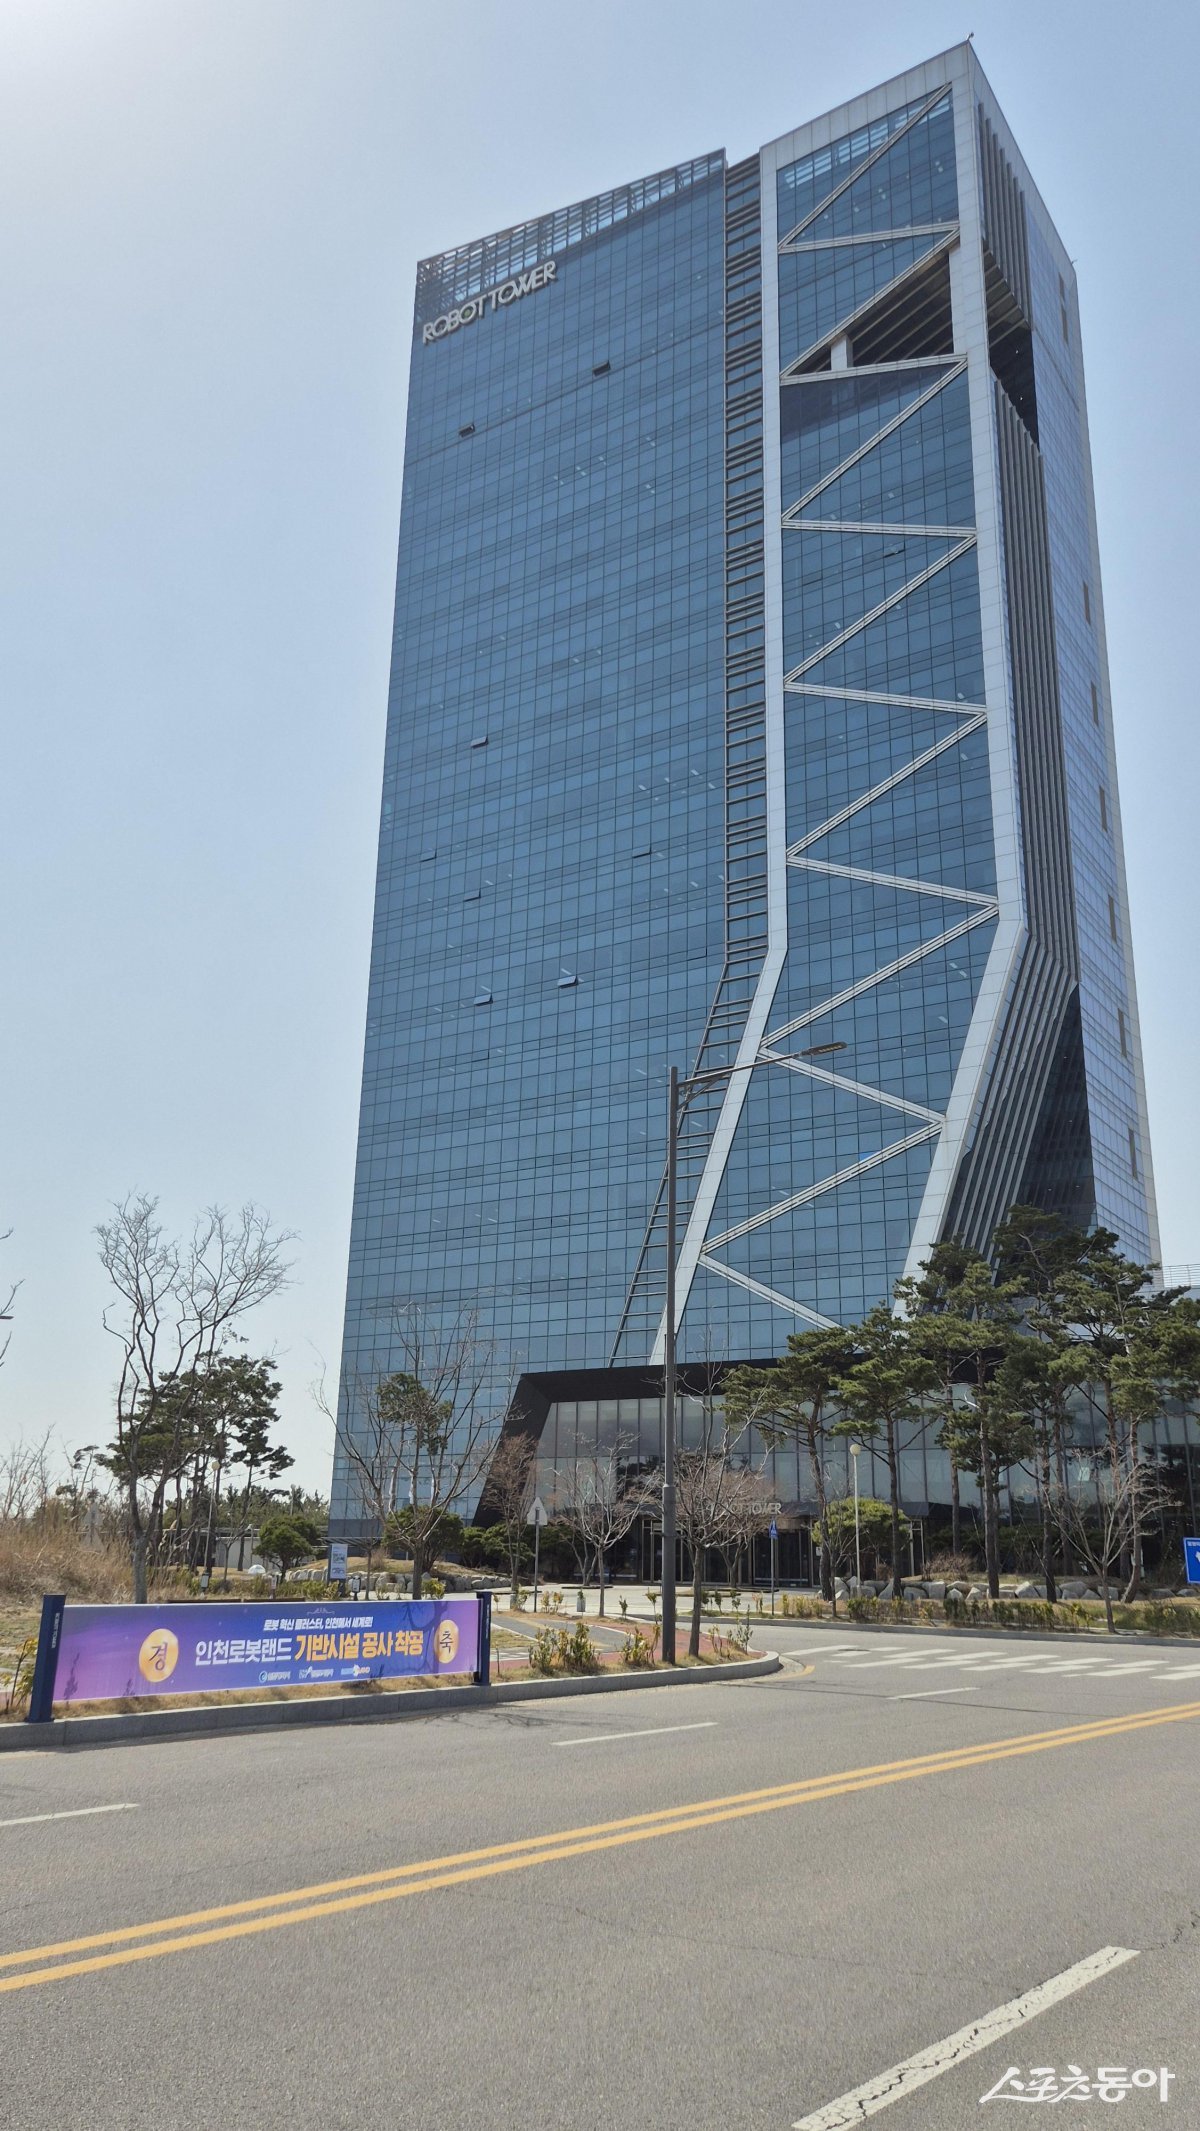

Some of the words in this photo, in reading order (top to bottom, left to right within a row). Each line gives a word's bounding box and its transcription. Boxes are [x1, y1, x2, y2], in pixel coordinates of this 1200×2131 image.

[422, 295, 488, 344] ROBOT
[488, 260, 557, 310] TOWER
[263, 1619, 279, 1631] 로봇
[279, 1618, 295, 1631] 혁신
[149, 1641, 168, 1671] 경
[195, 1638, 293, 1666] 인천로봇랜드
[294, 1632, 360, 1661] 기반시설
[362, 1631, 394, 1658] 공사
[394, 1629, 424, 1656] 착공
[439, 1630, 454, 1653] 축
